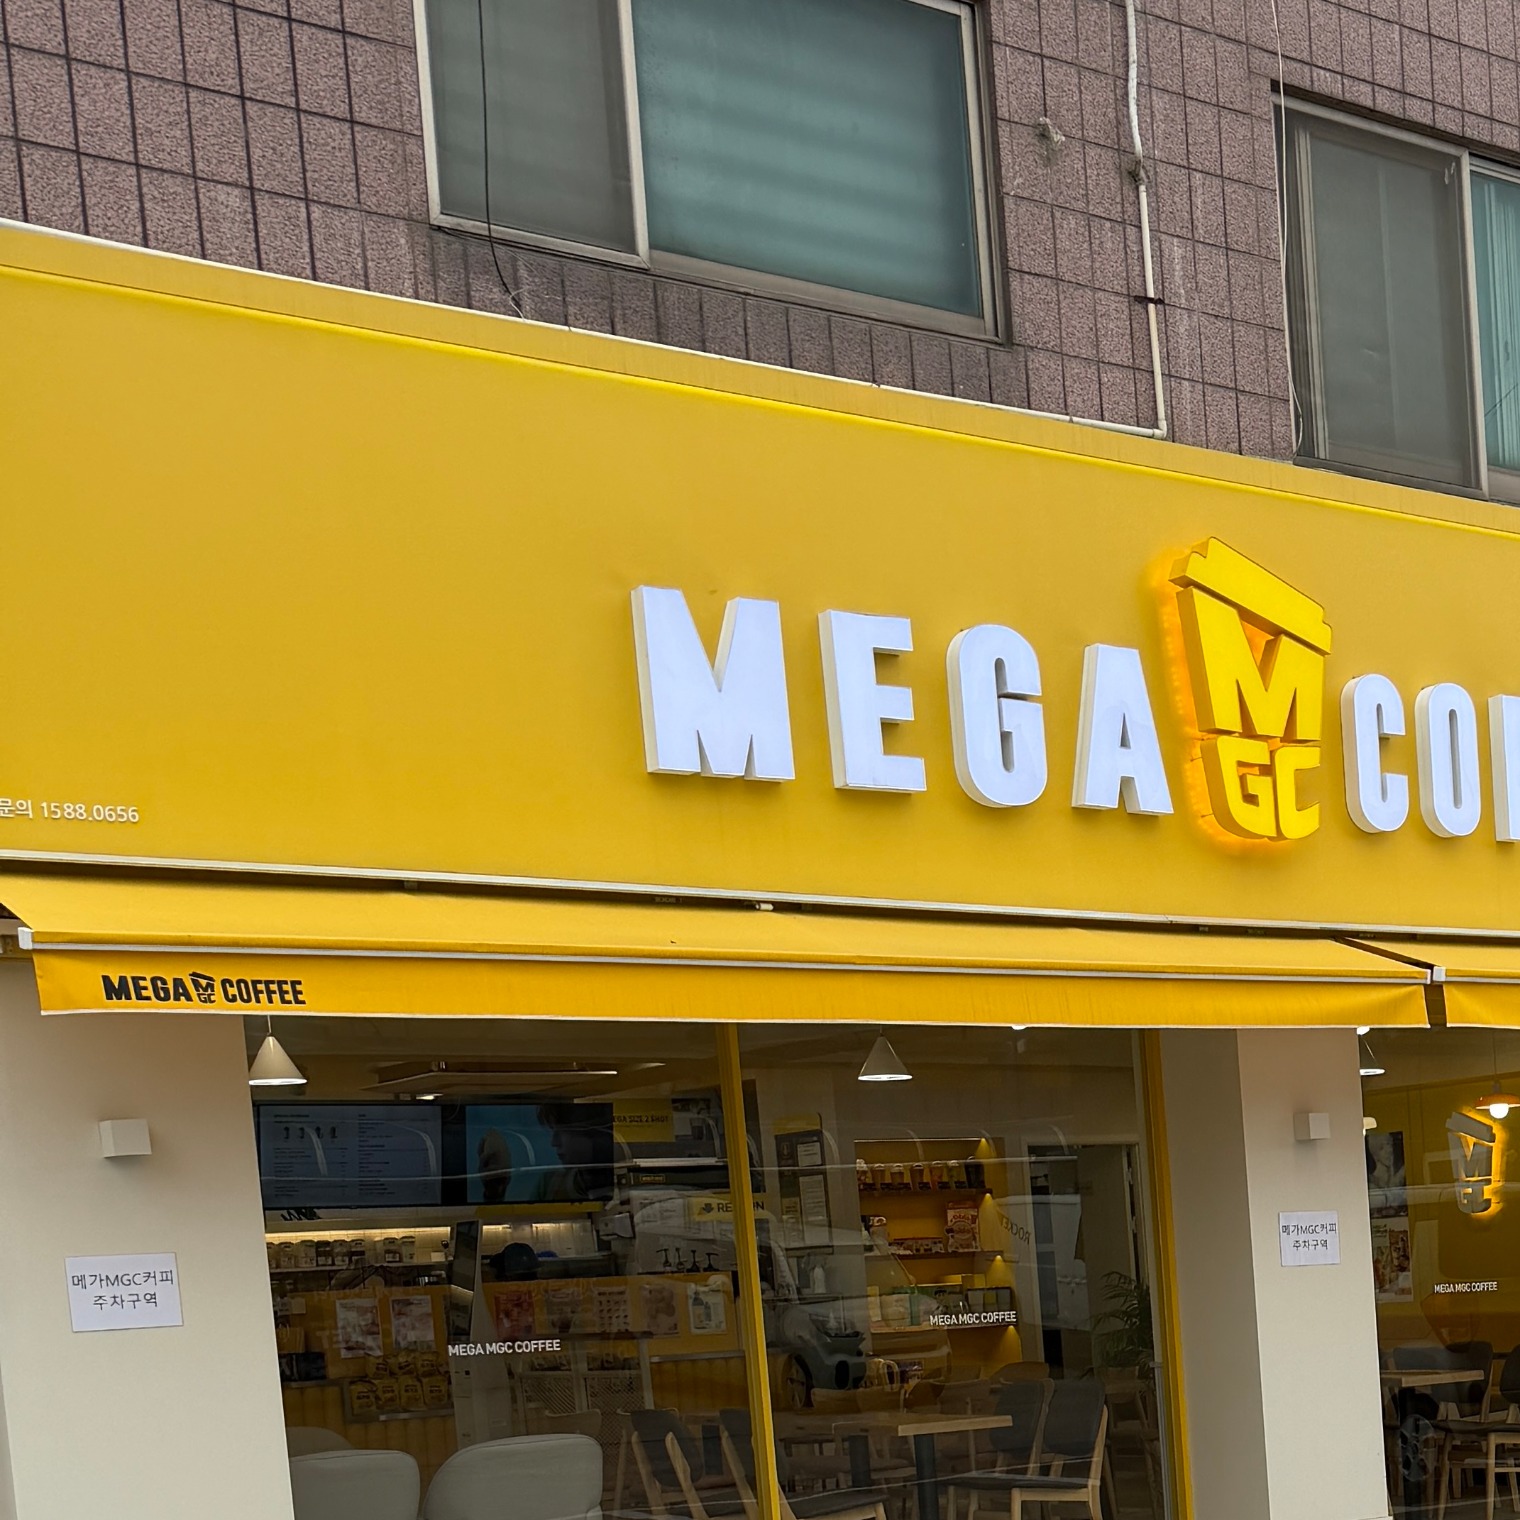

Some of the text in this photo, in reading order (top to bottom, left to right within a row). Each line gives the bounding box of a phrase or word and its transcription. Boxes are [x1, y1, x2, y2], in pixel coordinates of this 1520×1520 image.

[631, 584, 1175, 817] MEGA
[41, 802, 139, 823] 1588.0656
[101, 975, 194, 1003] MEGA
[220, 978, 307, 1005] COFFEE
[1281, 1223, 1337, 1236] 메가MGC커피
[1292, 1239, 1328, 1251] 주차구역
[72, 1269, 174, 1289] 메가MGC커피
[1434, 1281, 1498, 1294] MEGA MGC COFFEE
[93, 1291, 158, 1311] 주차구역
[929, 1310, 1017, 1326] MEGA MGC COFFEE
[448, 1339, 561, 1357] MEGA MGC COFFEE
